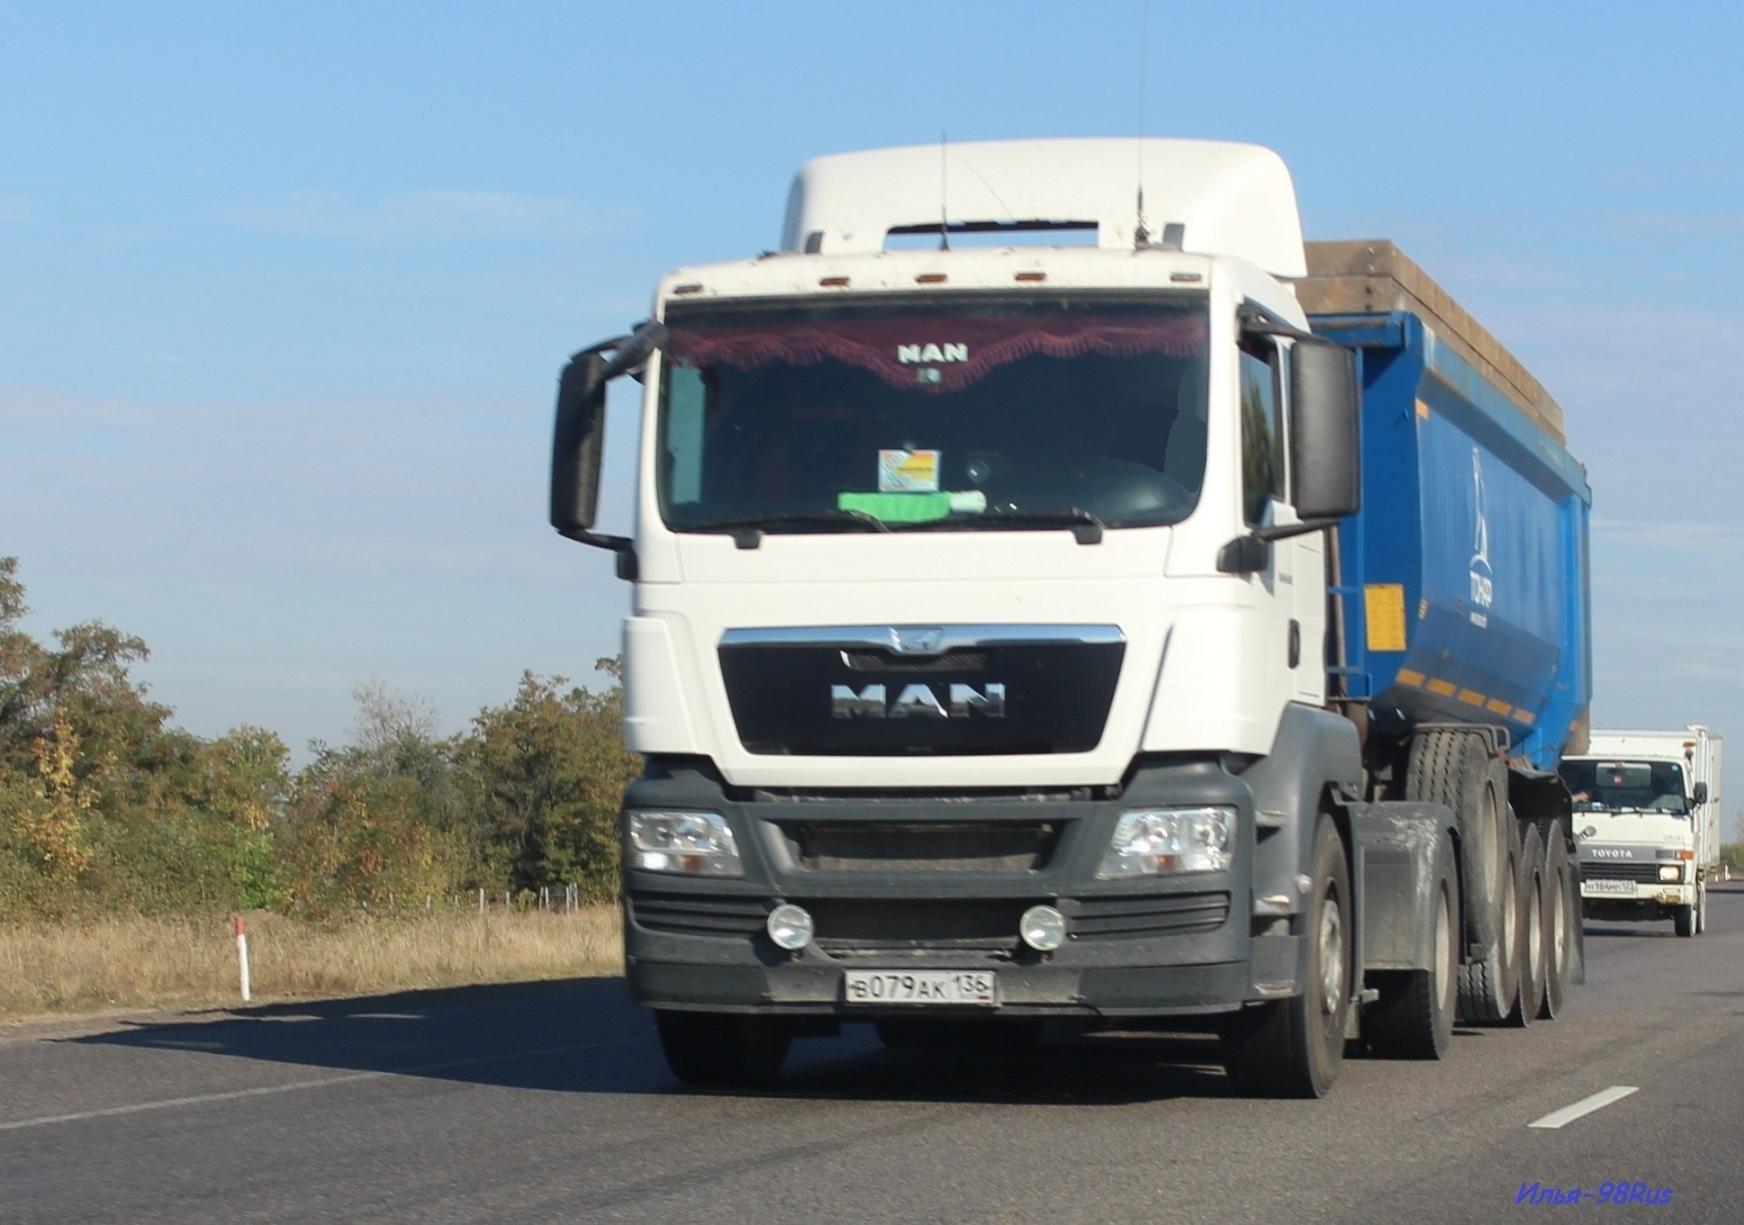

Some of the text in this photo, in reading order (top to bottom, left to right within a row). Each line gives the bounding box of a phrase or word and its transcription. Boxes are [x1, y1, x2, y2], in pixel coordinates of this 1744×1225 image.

[898, 343, 968, 363] MAN
[831, 683, 1006, 718] MAN
[1592, 849, 1632, 858] TOYOTA
